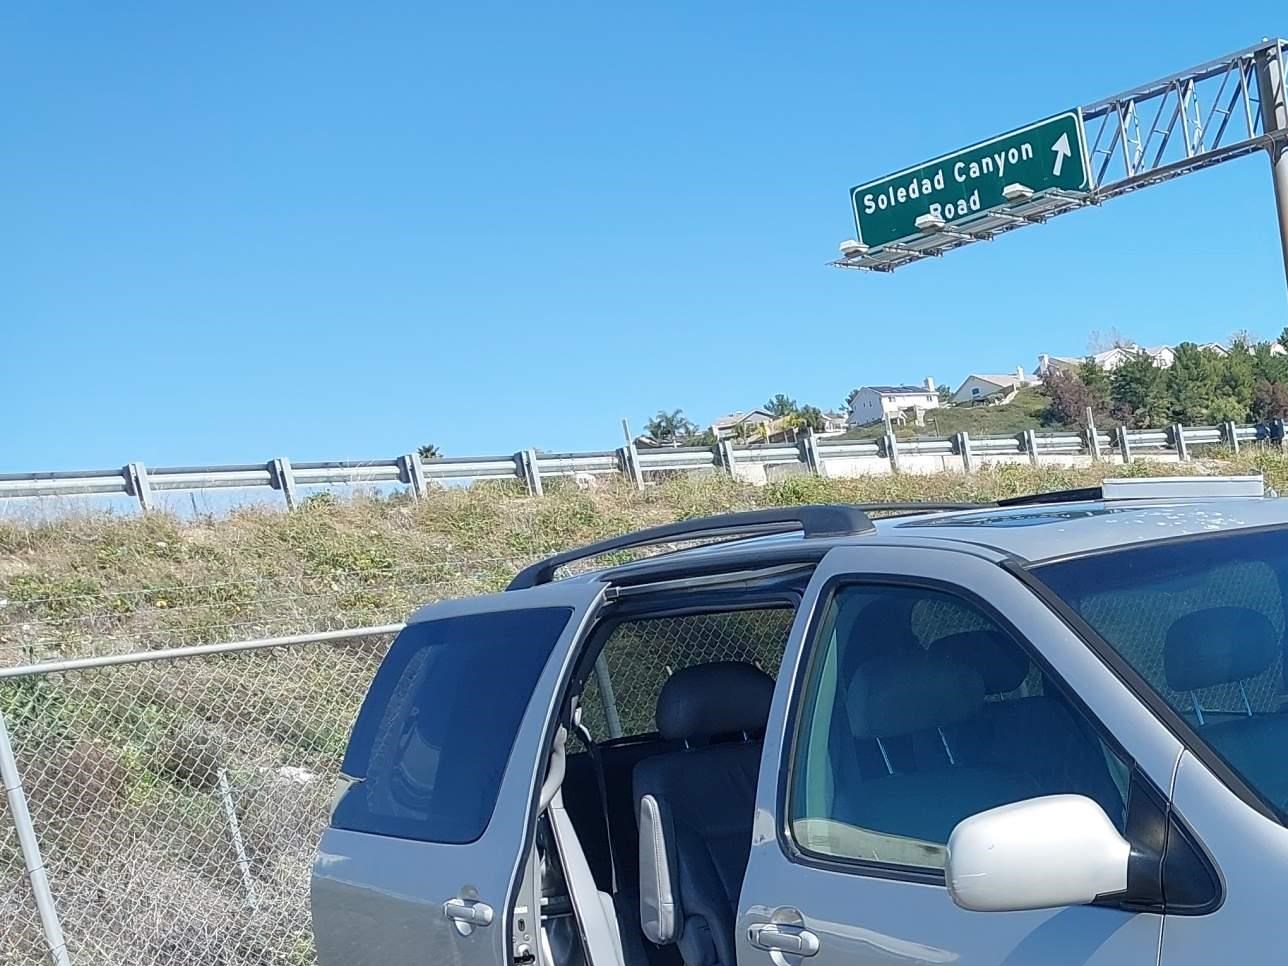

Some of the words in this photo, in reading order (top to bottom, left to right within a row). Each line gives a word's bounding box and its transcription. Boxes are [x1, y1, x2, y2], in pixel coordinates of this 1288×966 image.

[863, 168, 945, 215] Soledad
[953, 142, 1033, 182] Canyon
[929, 188, 981, 220] Road
